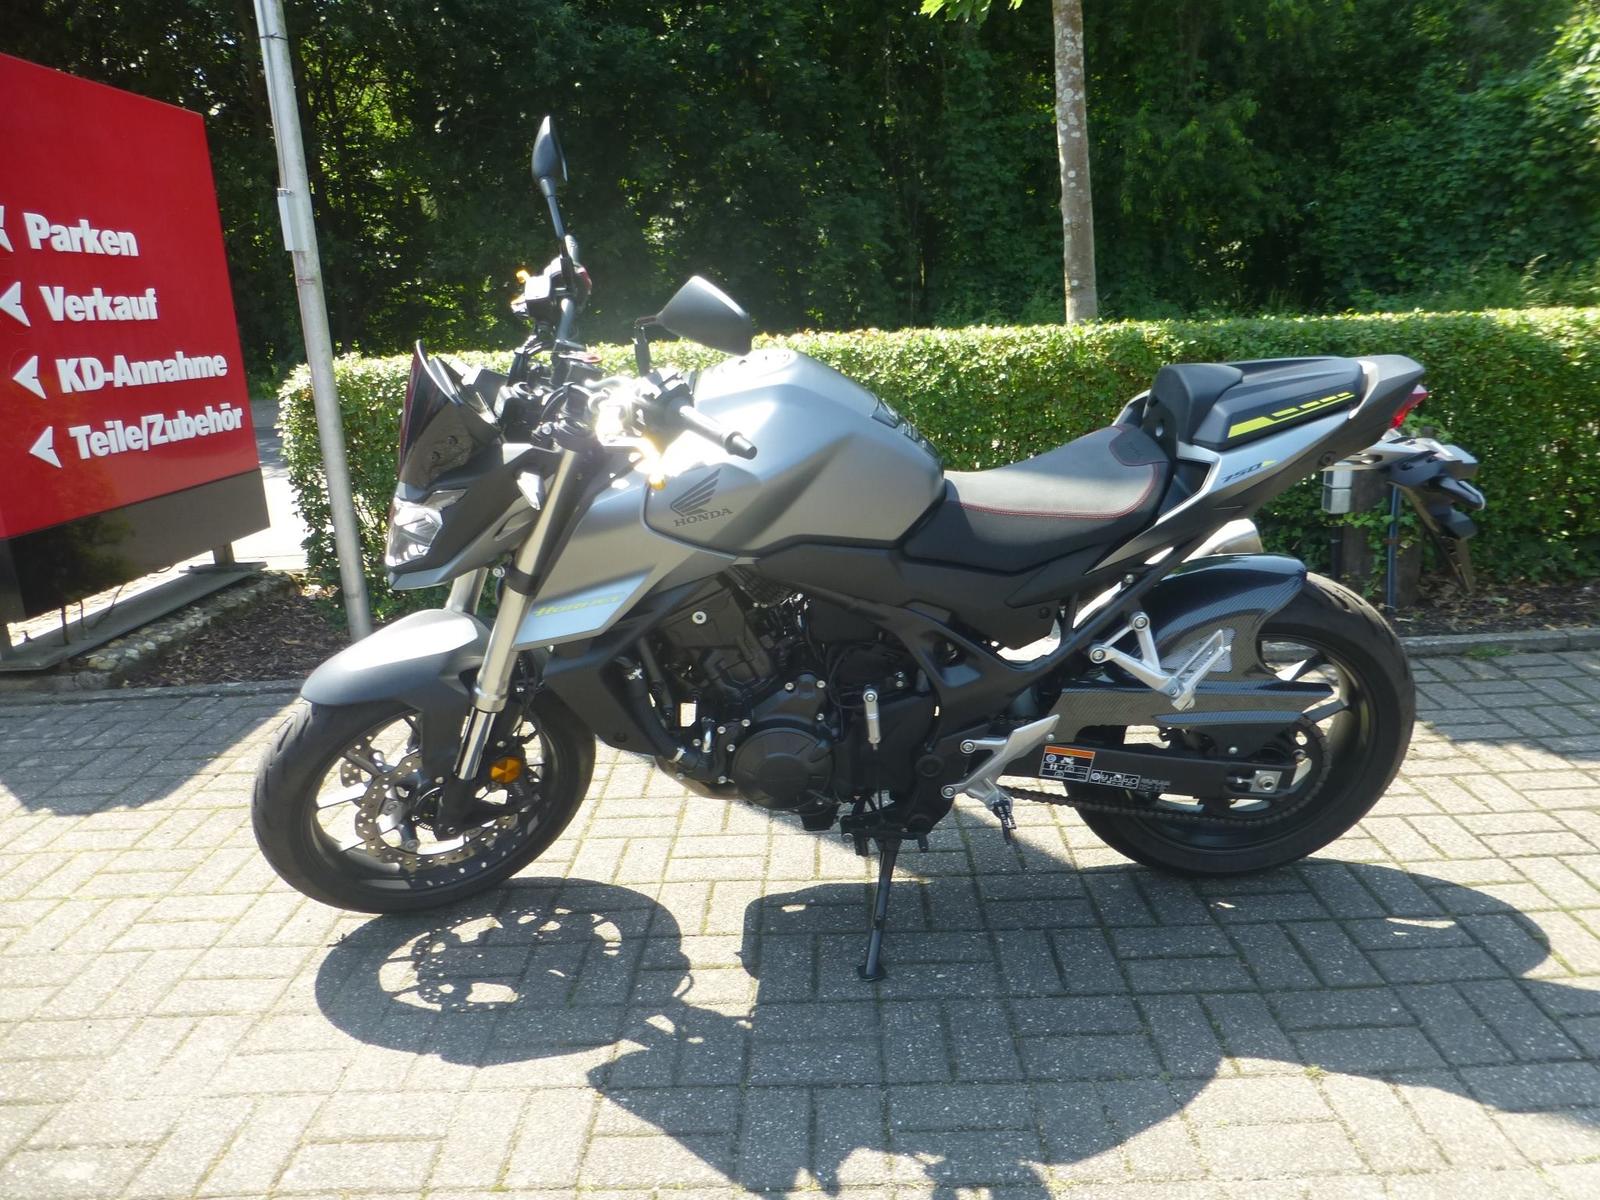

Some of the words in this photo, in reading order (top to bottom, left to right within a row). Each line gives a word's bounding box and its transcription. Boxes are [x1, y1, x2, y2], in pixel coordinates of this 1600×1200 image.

[24, 212, 139, 256] Parken
[39, 286, 158, 321] Verkauf
[55, 351, 227, 393] KD-Annahme
[68, 402, 243, 459] Teile/Zubehör
[673, 508, 733, 527] HONDA
